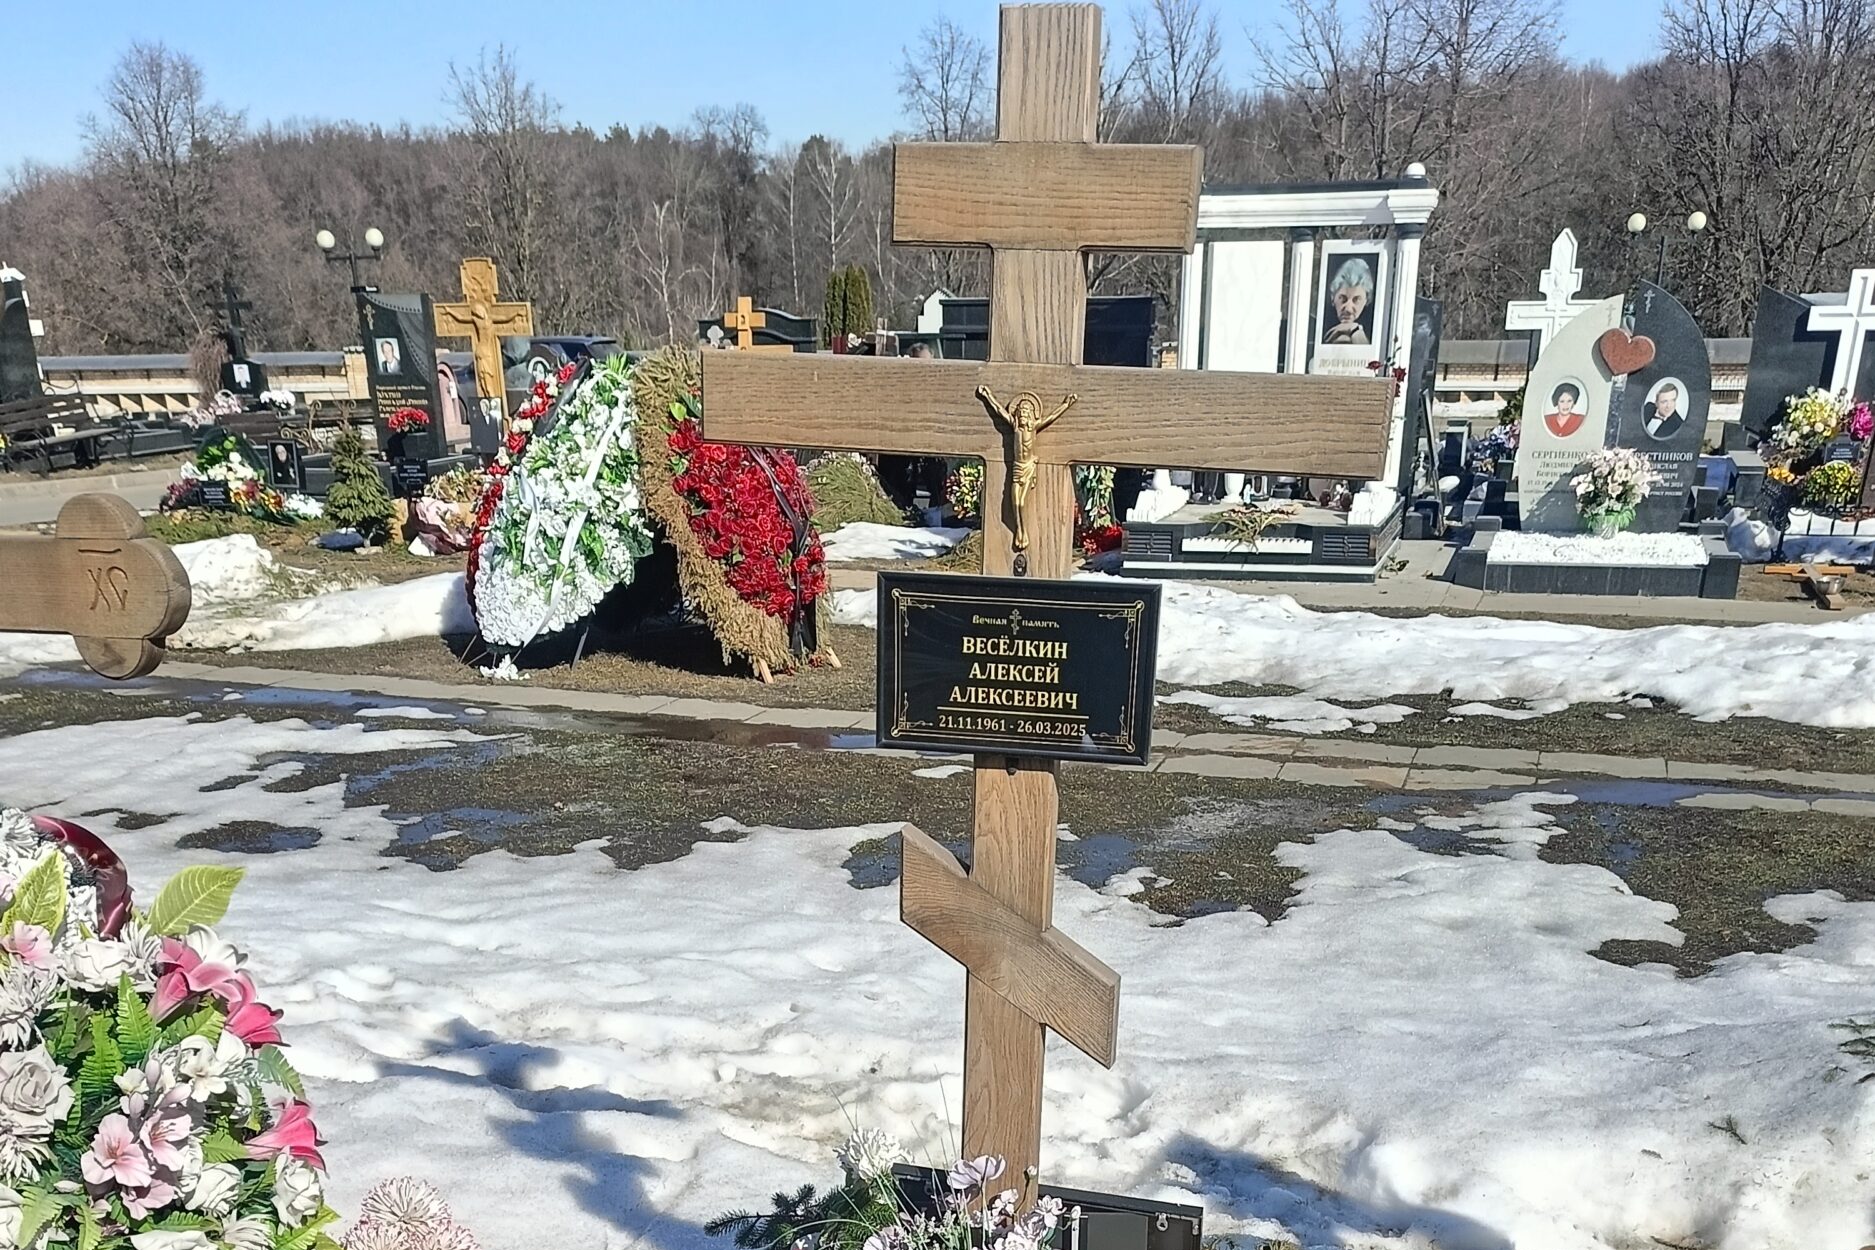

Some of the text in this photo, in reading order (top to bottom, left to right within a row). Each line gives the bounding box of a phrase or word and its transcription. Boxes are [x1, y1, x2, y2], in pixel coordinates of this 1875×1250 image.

[972, 614, 1060, 629] Вечная память
[962, 635, 1068, 659] ВЕСЁЛКИН
[968, 662, 1060, 684] АЛЕКСЕЙ
[949, 685, 1078, 710] АЛЕКСЕЕВИЧ
[938, 714, 1007, 732] 21.11.1961
[1017, 720, 1087, 737] 26.03.2025
